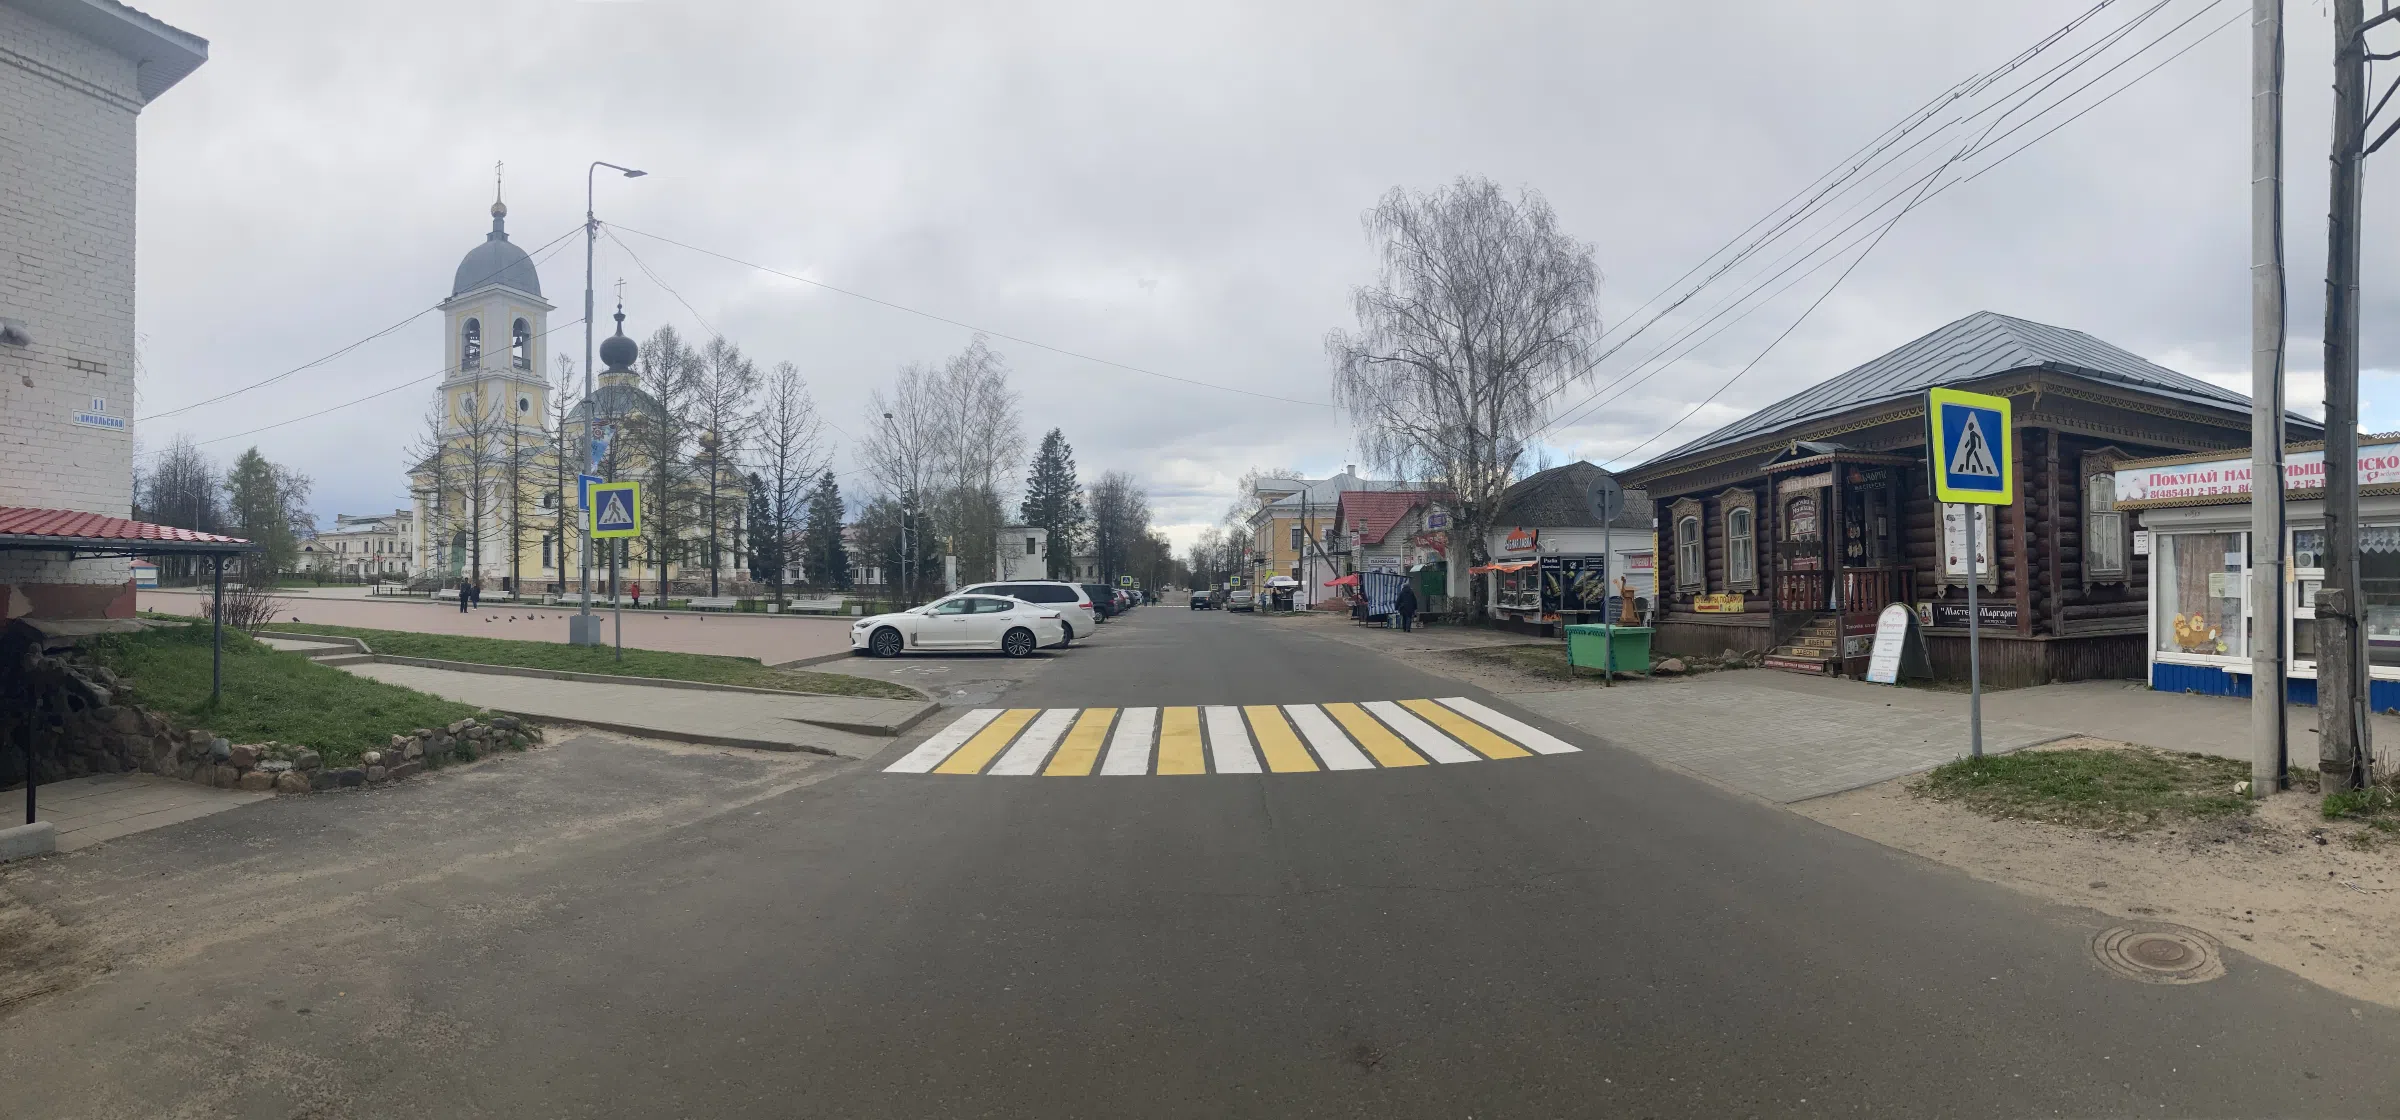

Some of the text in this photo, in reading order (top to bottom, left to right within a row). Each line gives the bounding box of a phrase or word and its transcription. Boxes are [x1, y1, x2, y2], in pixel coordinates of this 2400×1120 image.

[94, 399, 104, 410] 11
[80, 414, 122, 427] НИКОЛЬСКАЯ
[2150, 487, 2194, 499] 8(48544)
[1940, 607, 2018, 619] "Масте Маргарит
